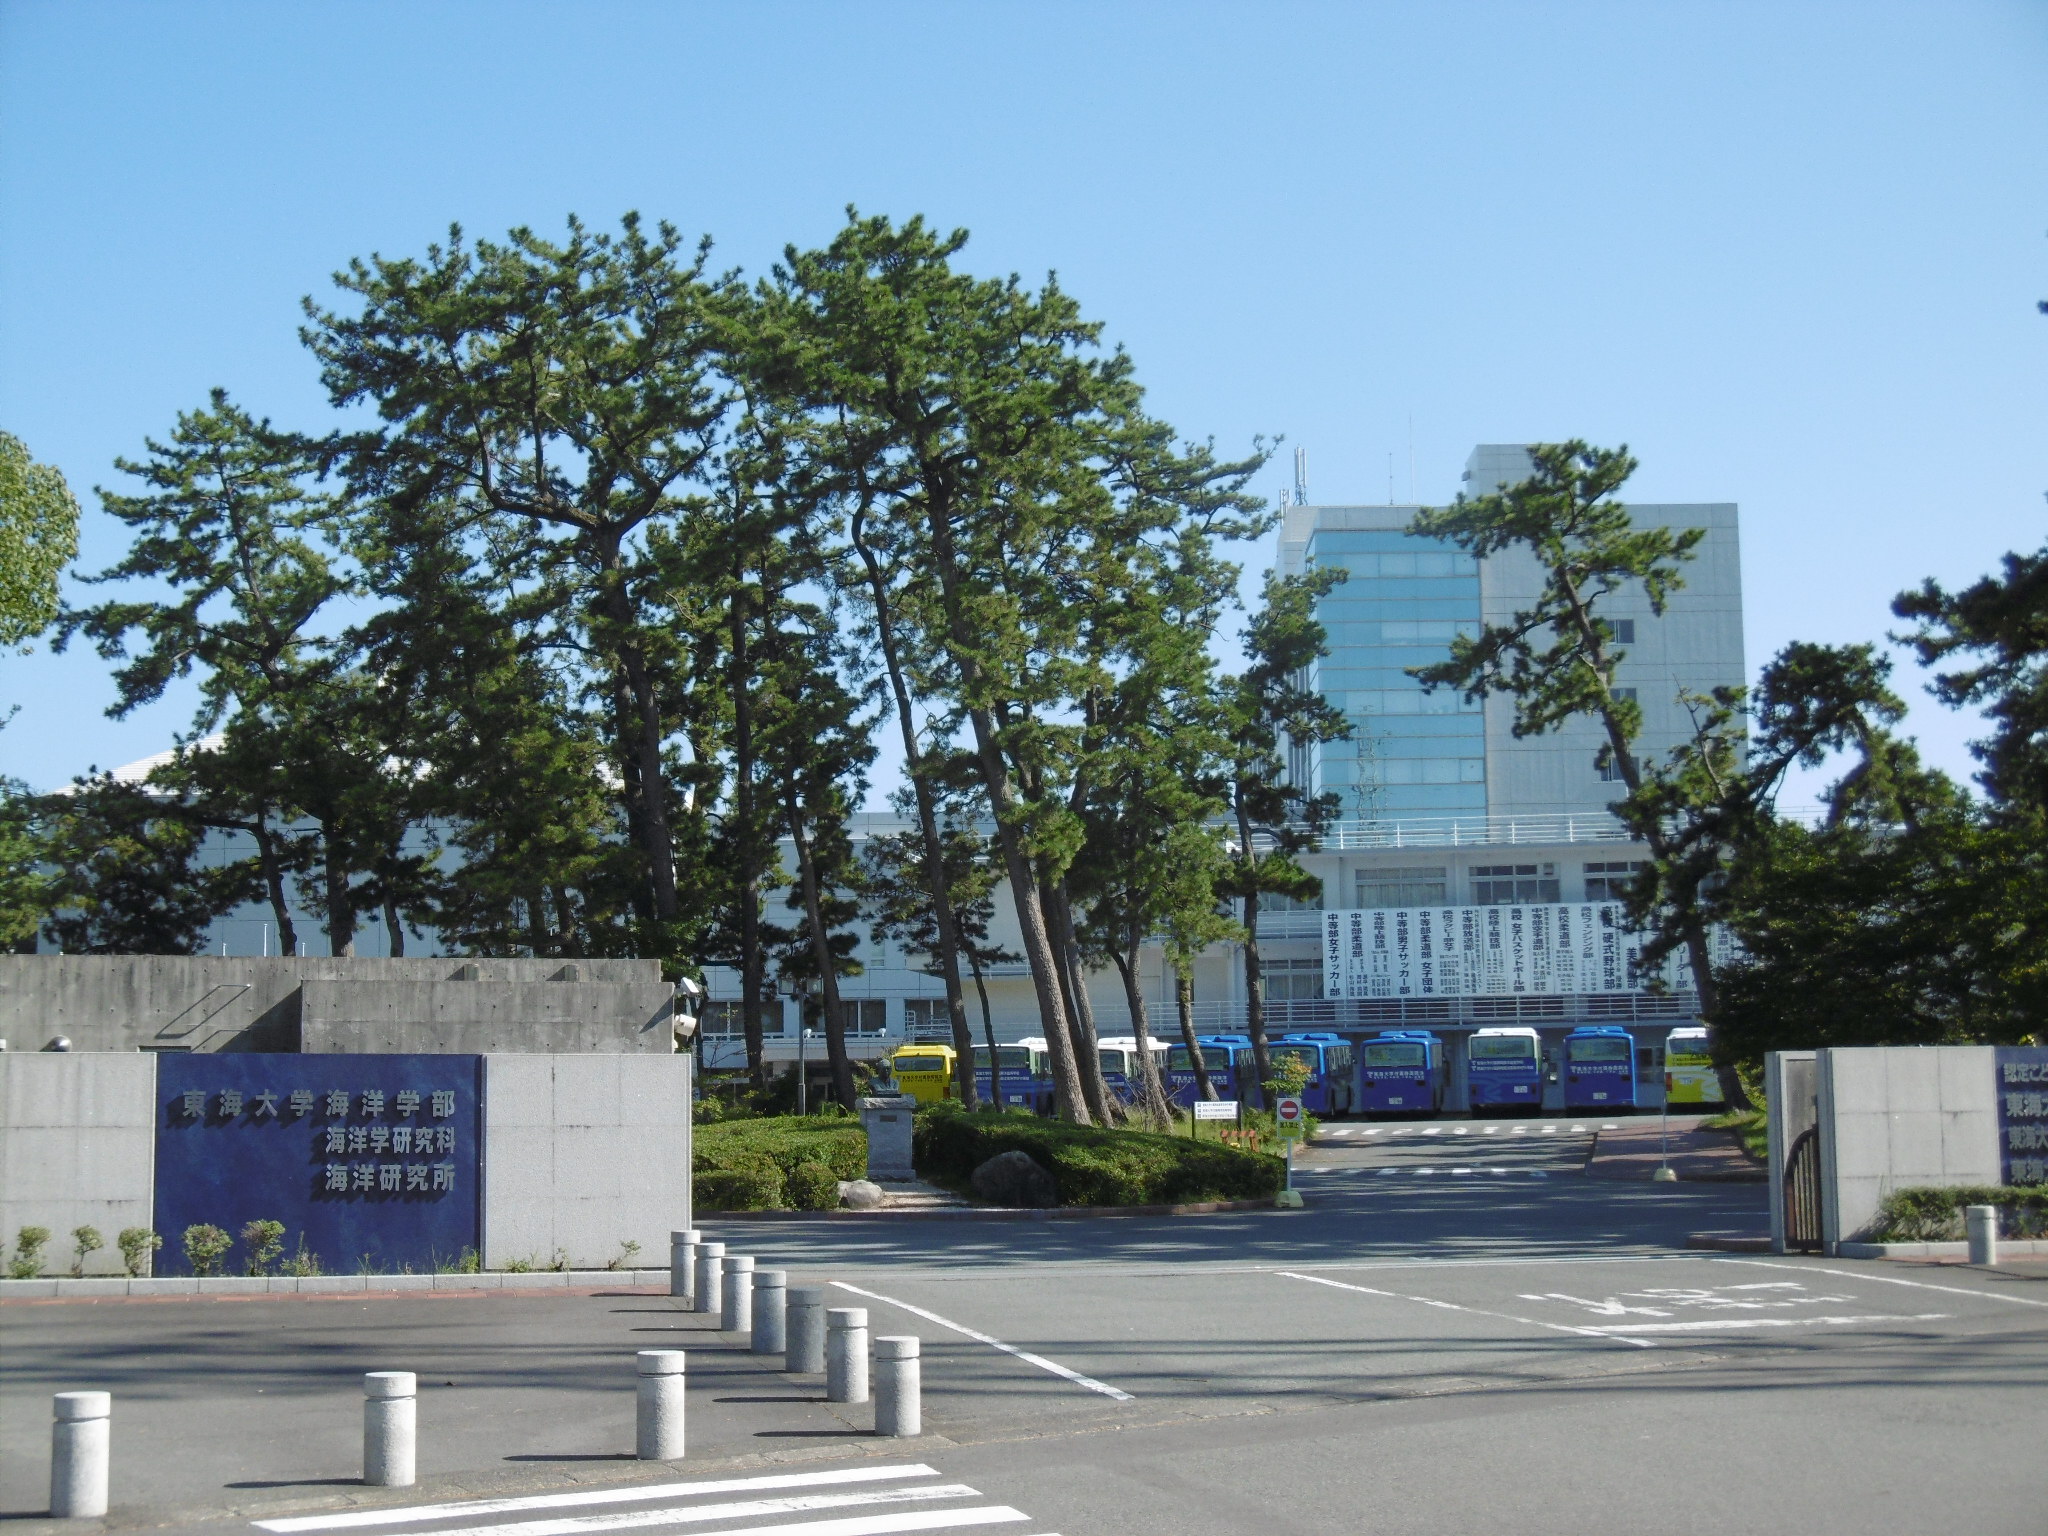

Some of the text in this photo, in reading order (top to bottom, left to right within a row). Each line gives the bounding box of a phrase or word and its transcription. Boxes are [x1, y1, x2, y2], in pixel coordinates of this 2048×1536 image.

[1351, 912, 1363, 958] 中等部柔道部
[1511, 907, 1523, 921] 高校
[1558, 906, 1571, 948] 高校柔道部
[1328, 912, 1340, 997] 中等部女子サッカー部
[1397, 911, 1411, 995] 中等部男子サッカー部
[1420, 910, 1434, 994] 中等部柔道部 女子団体
[1602, 932, 1615, 990] 硬式野球部
[182, 1088, 455, 1118] 東海大学海洋学部
[325, 1126, 455, 1154] 海洋学研究科
[325, 1163, 454, 1192] 海洋研究所
[2010, 1158, 2048, 1183] 東海
